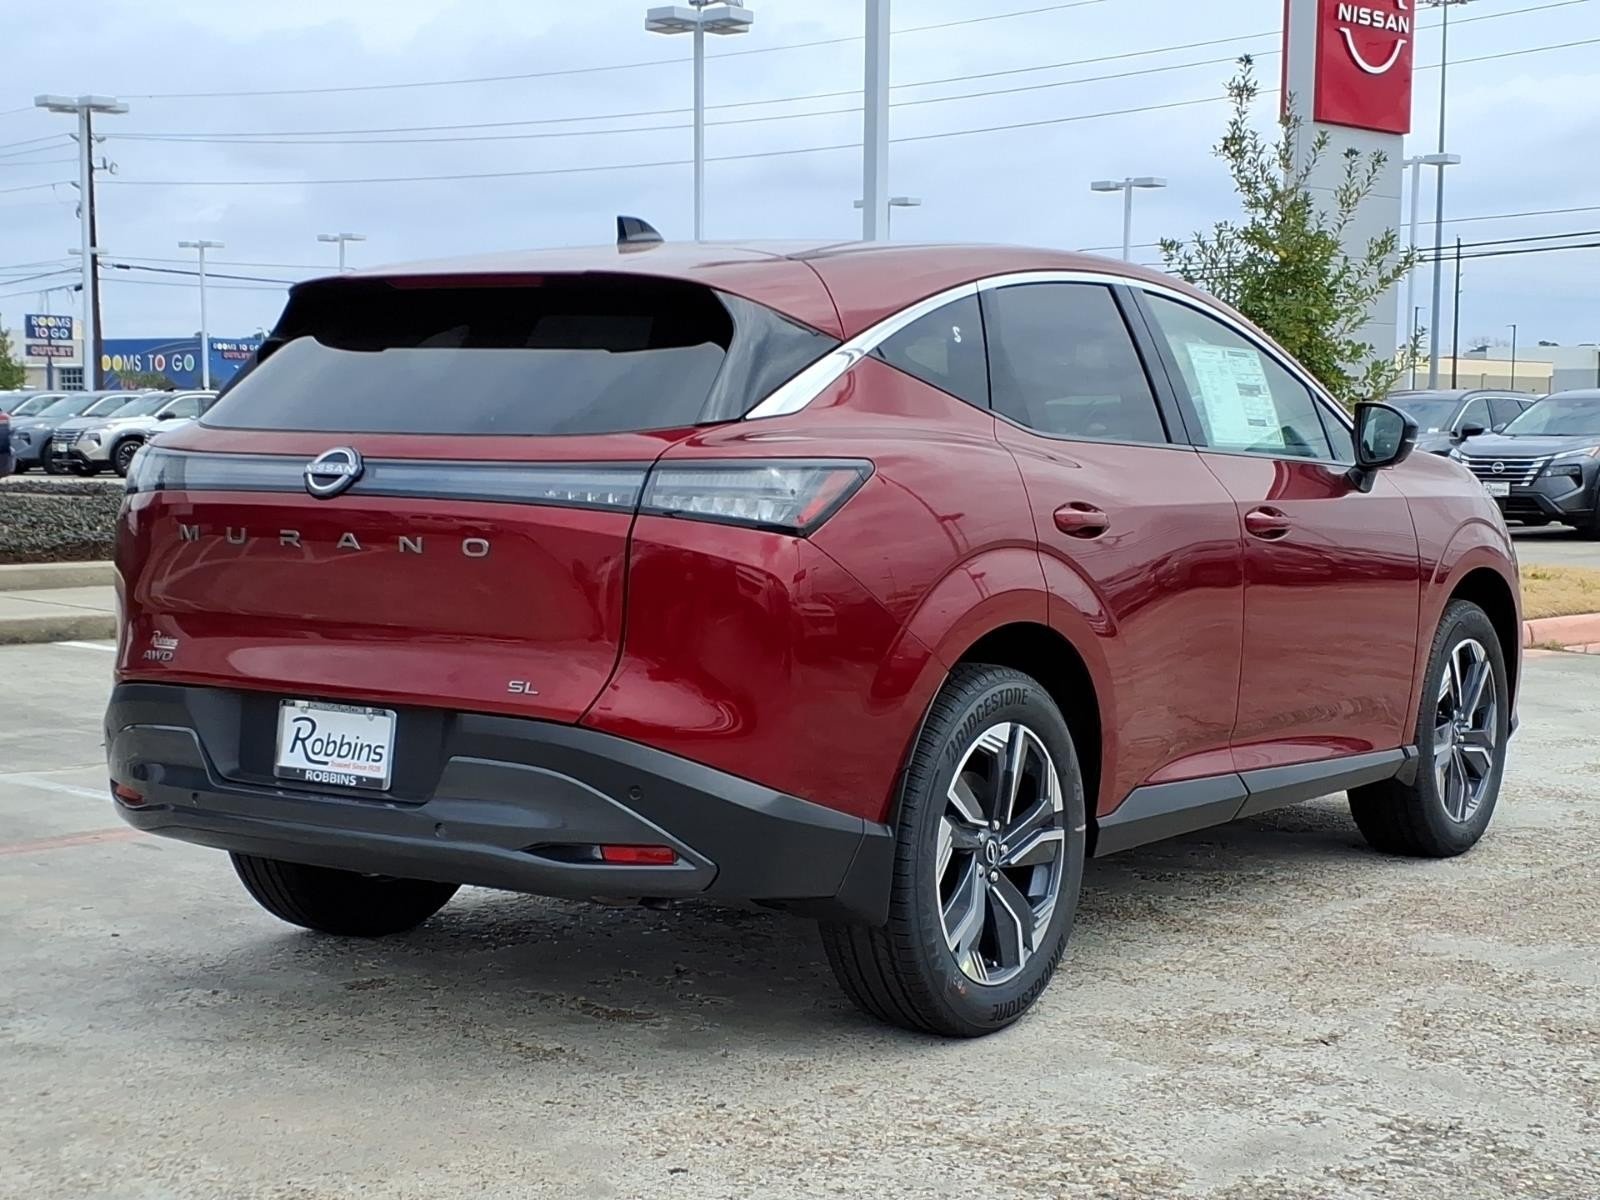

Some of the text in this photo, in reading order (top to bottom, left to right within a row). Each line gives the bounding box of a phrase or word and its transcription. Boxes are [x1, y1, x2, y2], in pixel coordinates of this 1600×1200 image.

[1338, 3, 1409, 33] NISSAN
[32, 316, 71, 328] ROOMS
[34, 327, 69, 338] TO GO
[32, 346, 72, 356] OUTLET
[101, 354, 195, 371] OOMS TO GO
[305, 463, 358, 475] NISSAN
[179, 524, 491, 558] MURANO
[143, 650, 173, 660] AWD
[507, 680, 539, 694] SL
[945, 687, 1029, 761] BRIDGESTONE
[290, 716, 385, 766] Robbins
[305, 770, 357, 787] ROBBINS
